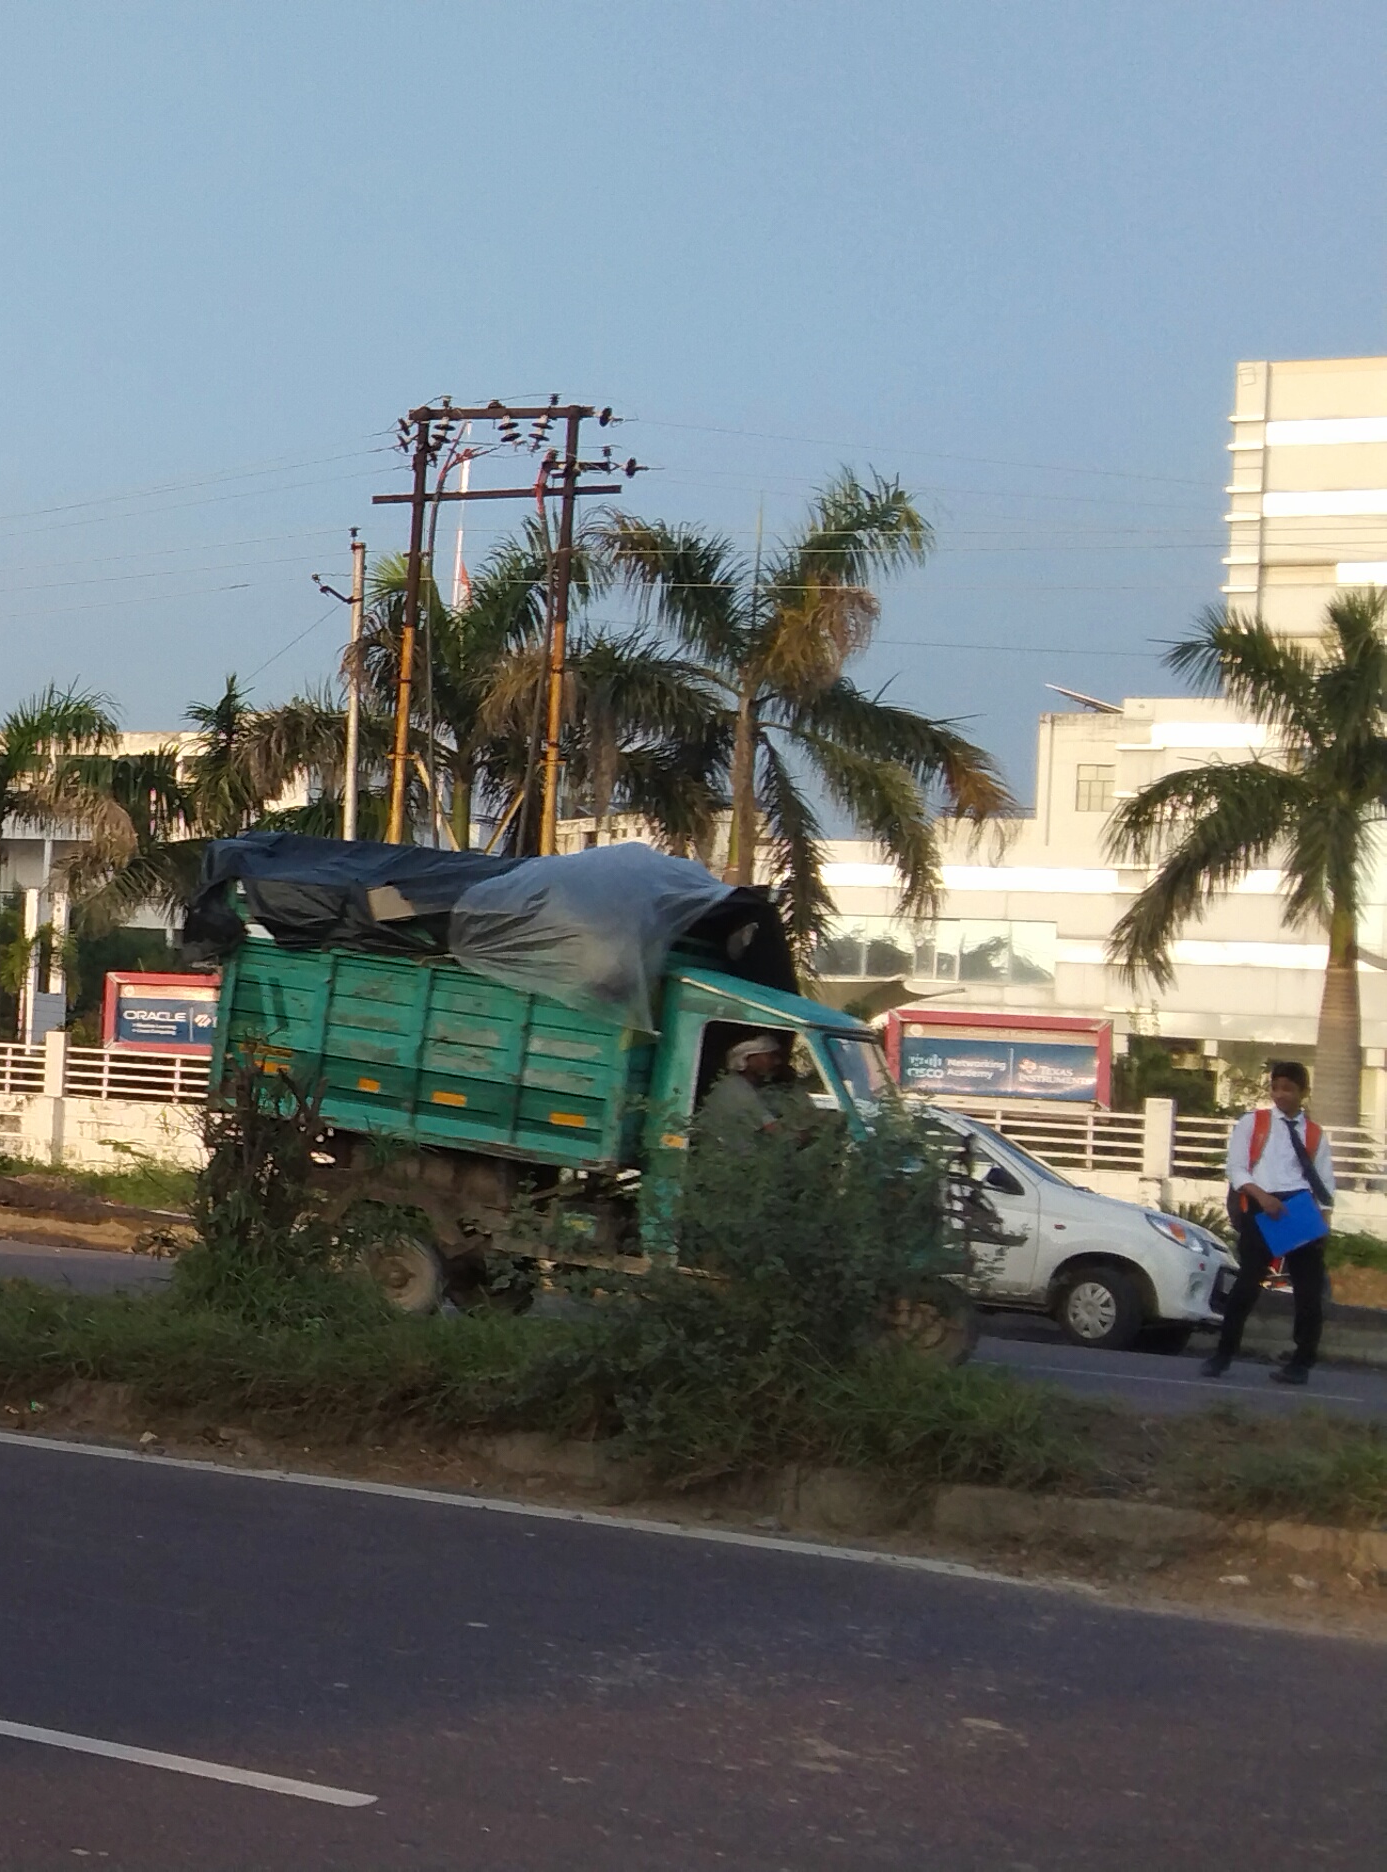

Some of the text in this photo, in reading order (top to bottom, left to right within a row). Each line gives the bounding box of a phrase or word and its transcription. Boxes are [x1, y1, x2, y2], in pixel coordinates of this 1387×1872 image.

[123, 1010, 186, 1022] ORACLE
[946, 1059, 1006, 1071] Networking
[1039, 1065, 1073, 1077] TEXAS
[947, 1068, 994, 1080] Academy
